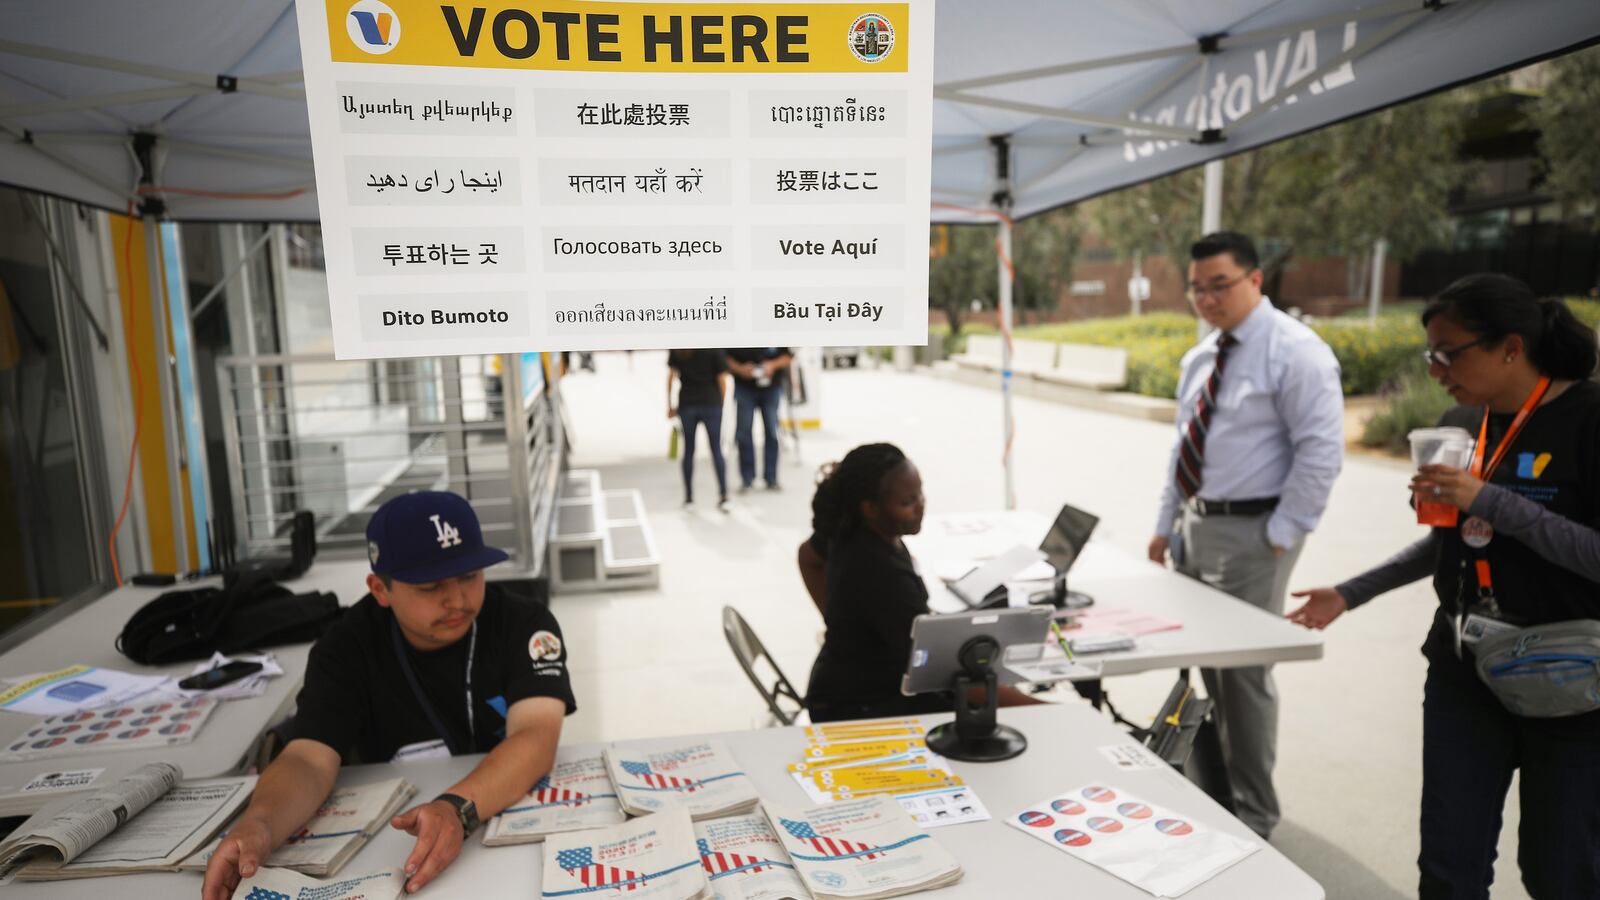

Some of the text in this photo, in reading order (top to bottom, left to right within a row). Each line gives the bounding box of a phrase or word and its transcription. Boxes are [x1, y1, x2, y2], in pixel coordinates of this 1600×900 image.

[440, 5, 810, 63] VOTE HERE
[342, 95, 512, 122] Այստեղ քվեարկեք
[577, 103, 690, 125] 在此處投票
[366, 174, 408, 193] دهید
[461, 170, 502, 193] اینجا
[568, 168, 703, 194] मतदान यहाँ करें
[777, 170, 878, 191] 投票はここ
[382, 243, 498, 266] 투표하는 곳
[554, 238, 722, 257] Голосовать здесь
[779, 238, 878, 259] Vote Aquí
[382, 309, 509, 326] Dito Bumoto
[555, 296, 727, 323] ออกเสียงลงคะแนนที่นี่
[774, 302, 883, 322] Bầu Tại Đây
[429, 514, 462, 549] LA
